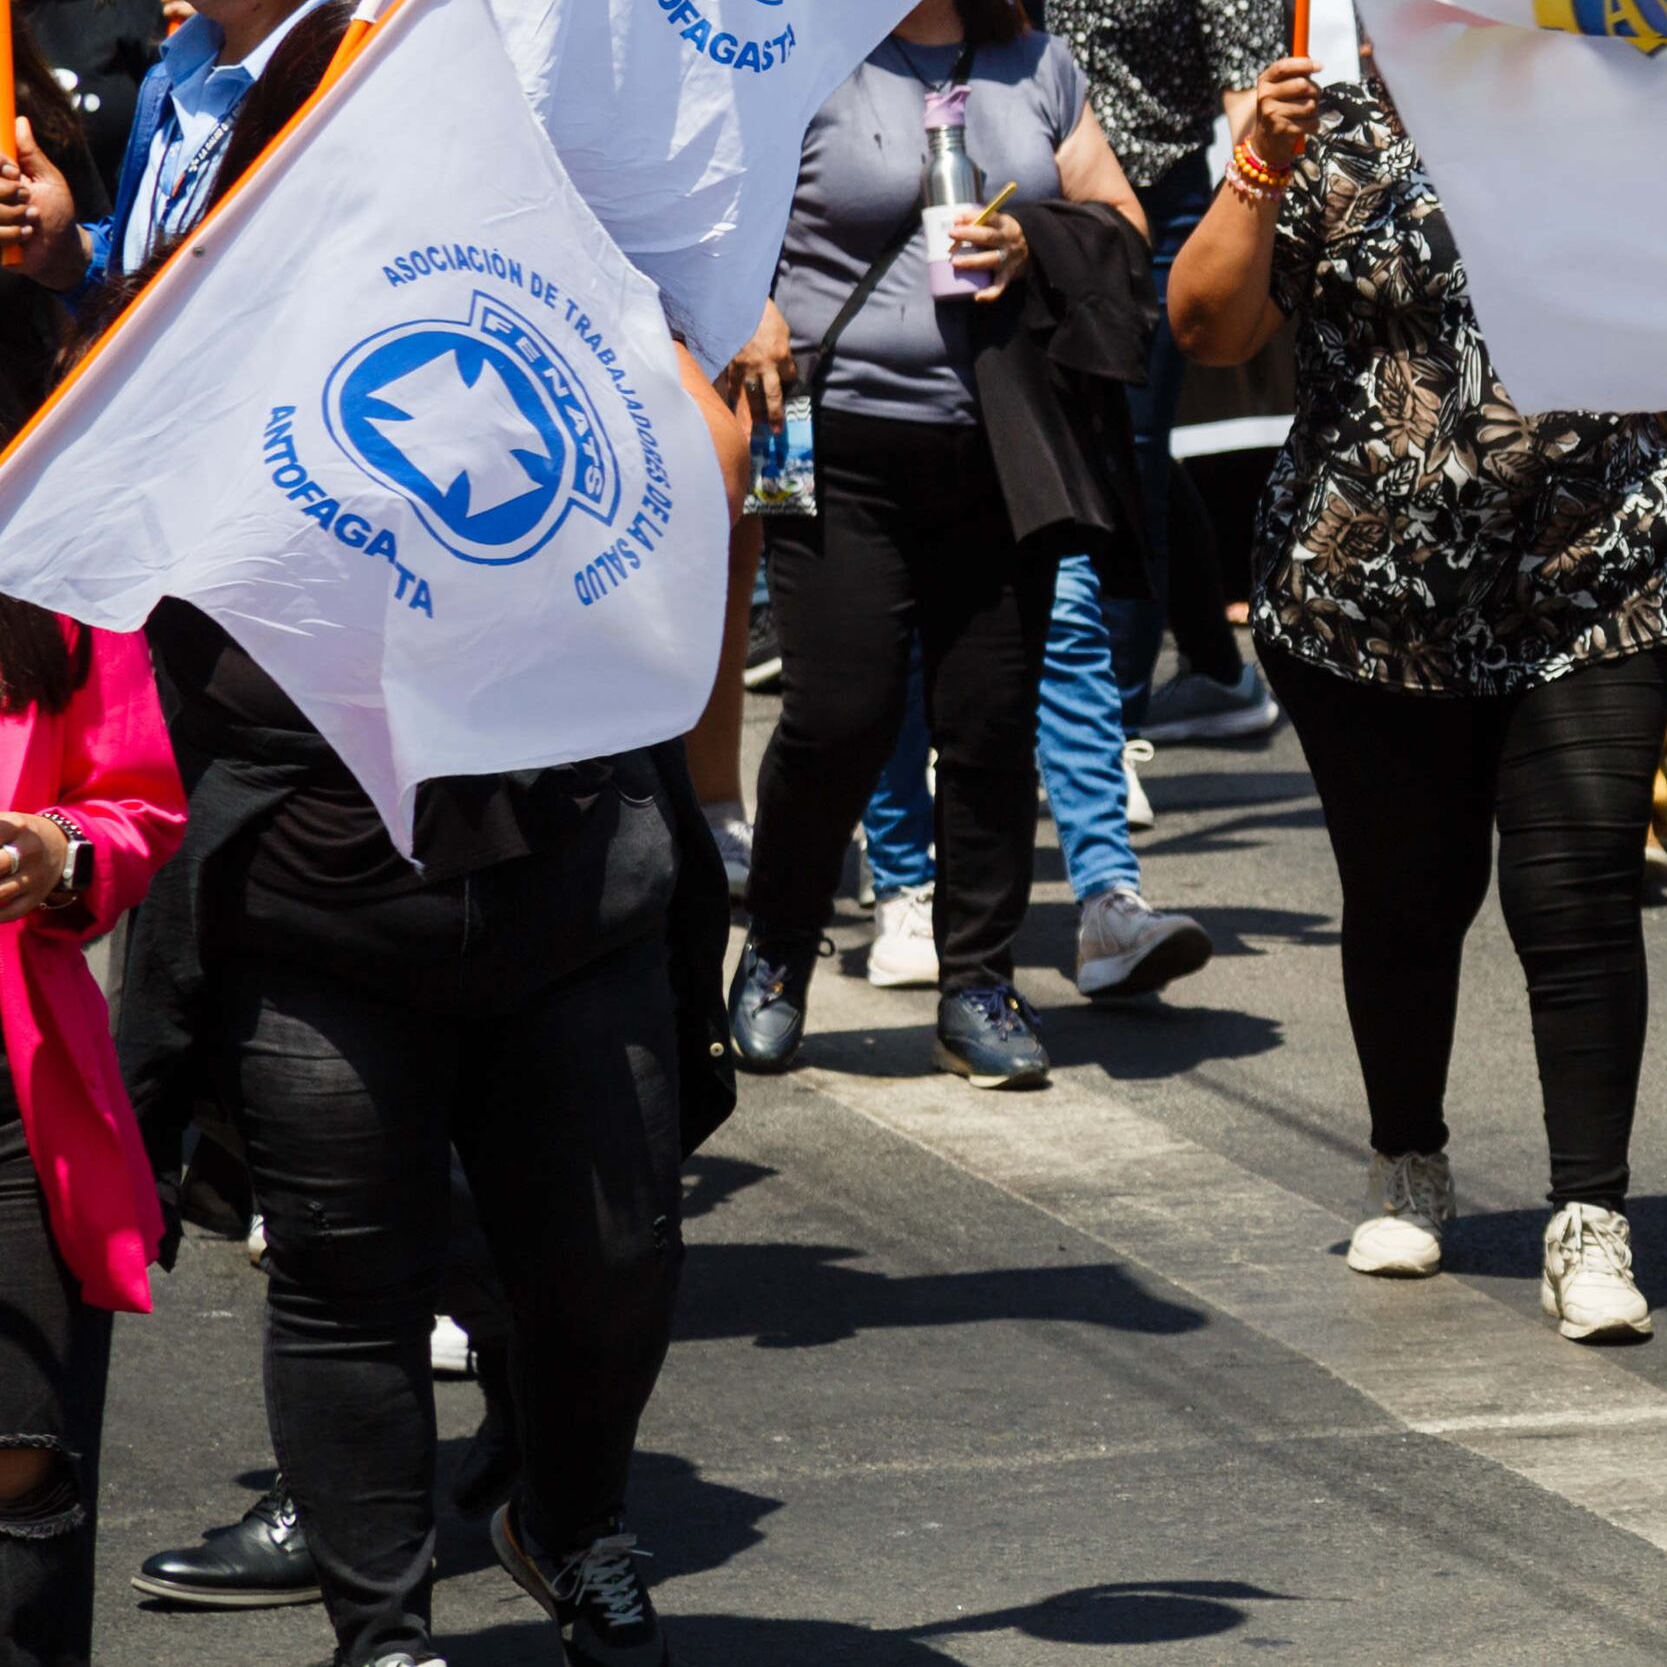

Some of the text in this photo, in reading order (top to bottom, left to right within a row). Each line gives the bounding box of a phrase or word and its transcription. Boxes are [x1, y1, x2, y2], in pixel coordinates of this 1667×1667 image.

[262, 405, 435, 619] ANTOFAGATA
[382, 243, 674, 608] ASOCIACIÓN DE TRABAJADORES DE LA SALUD
[483, 313, 602, 500] FENATS
